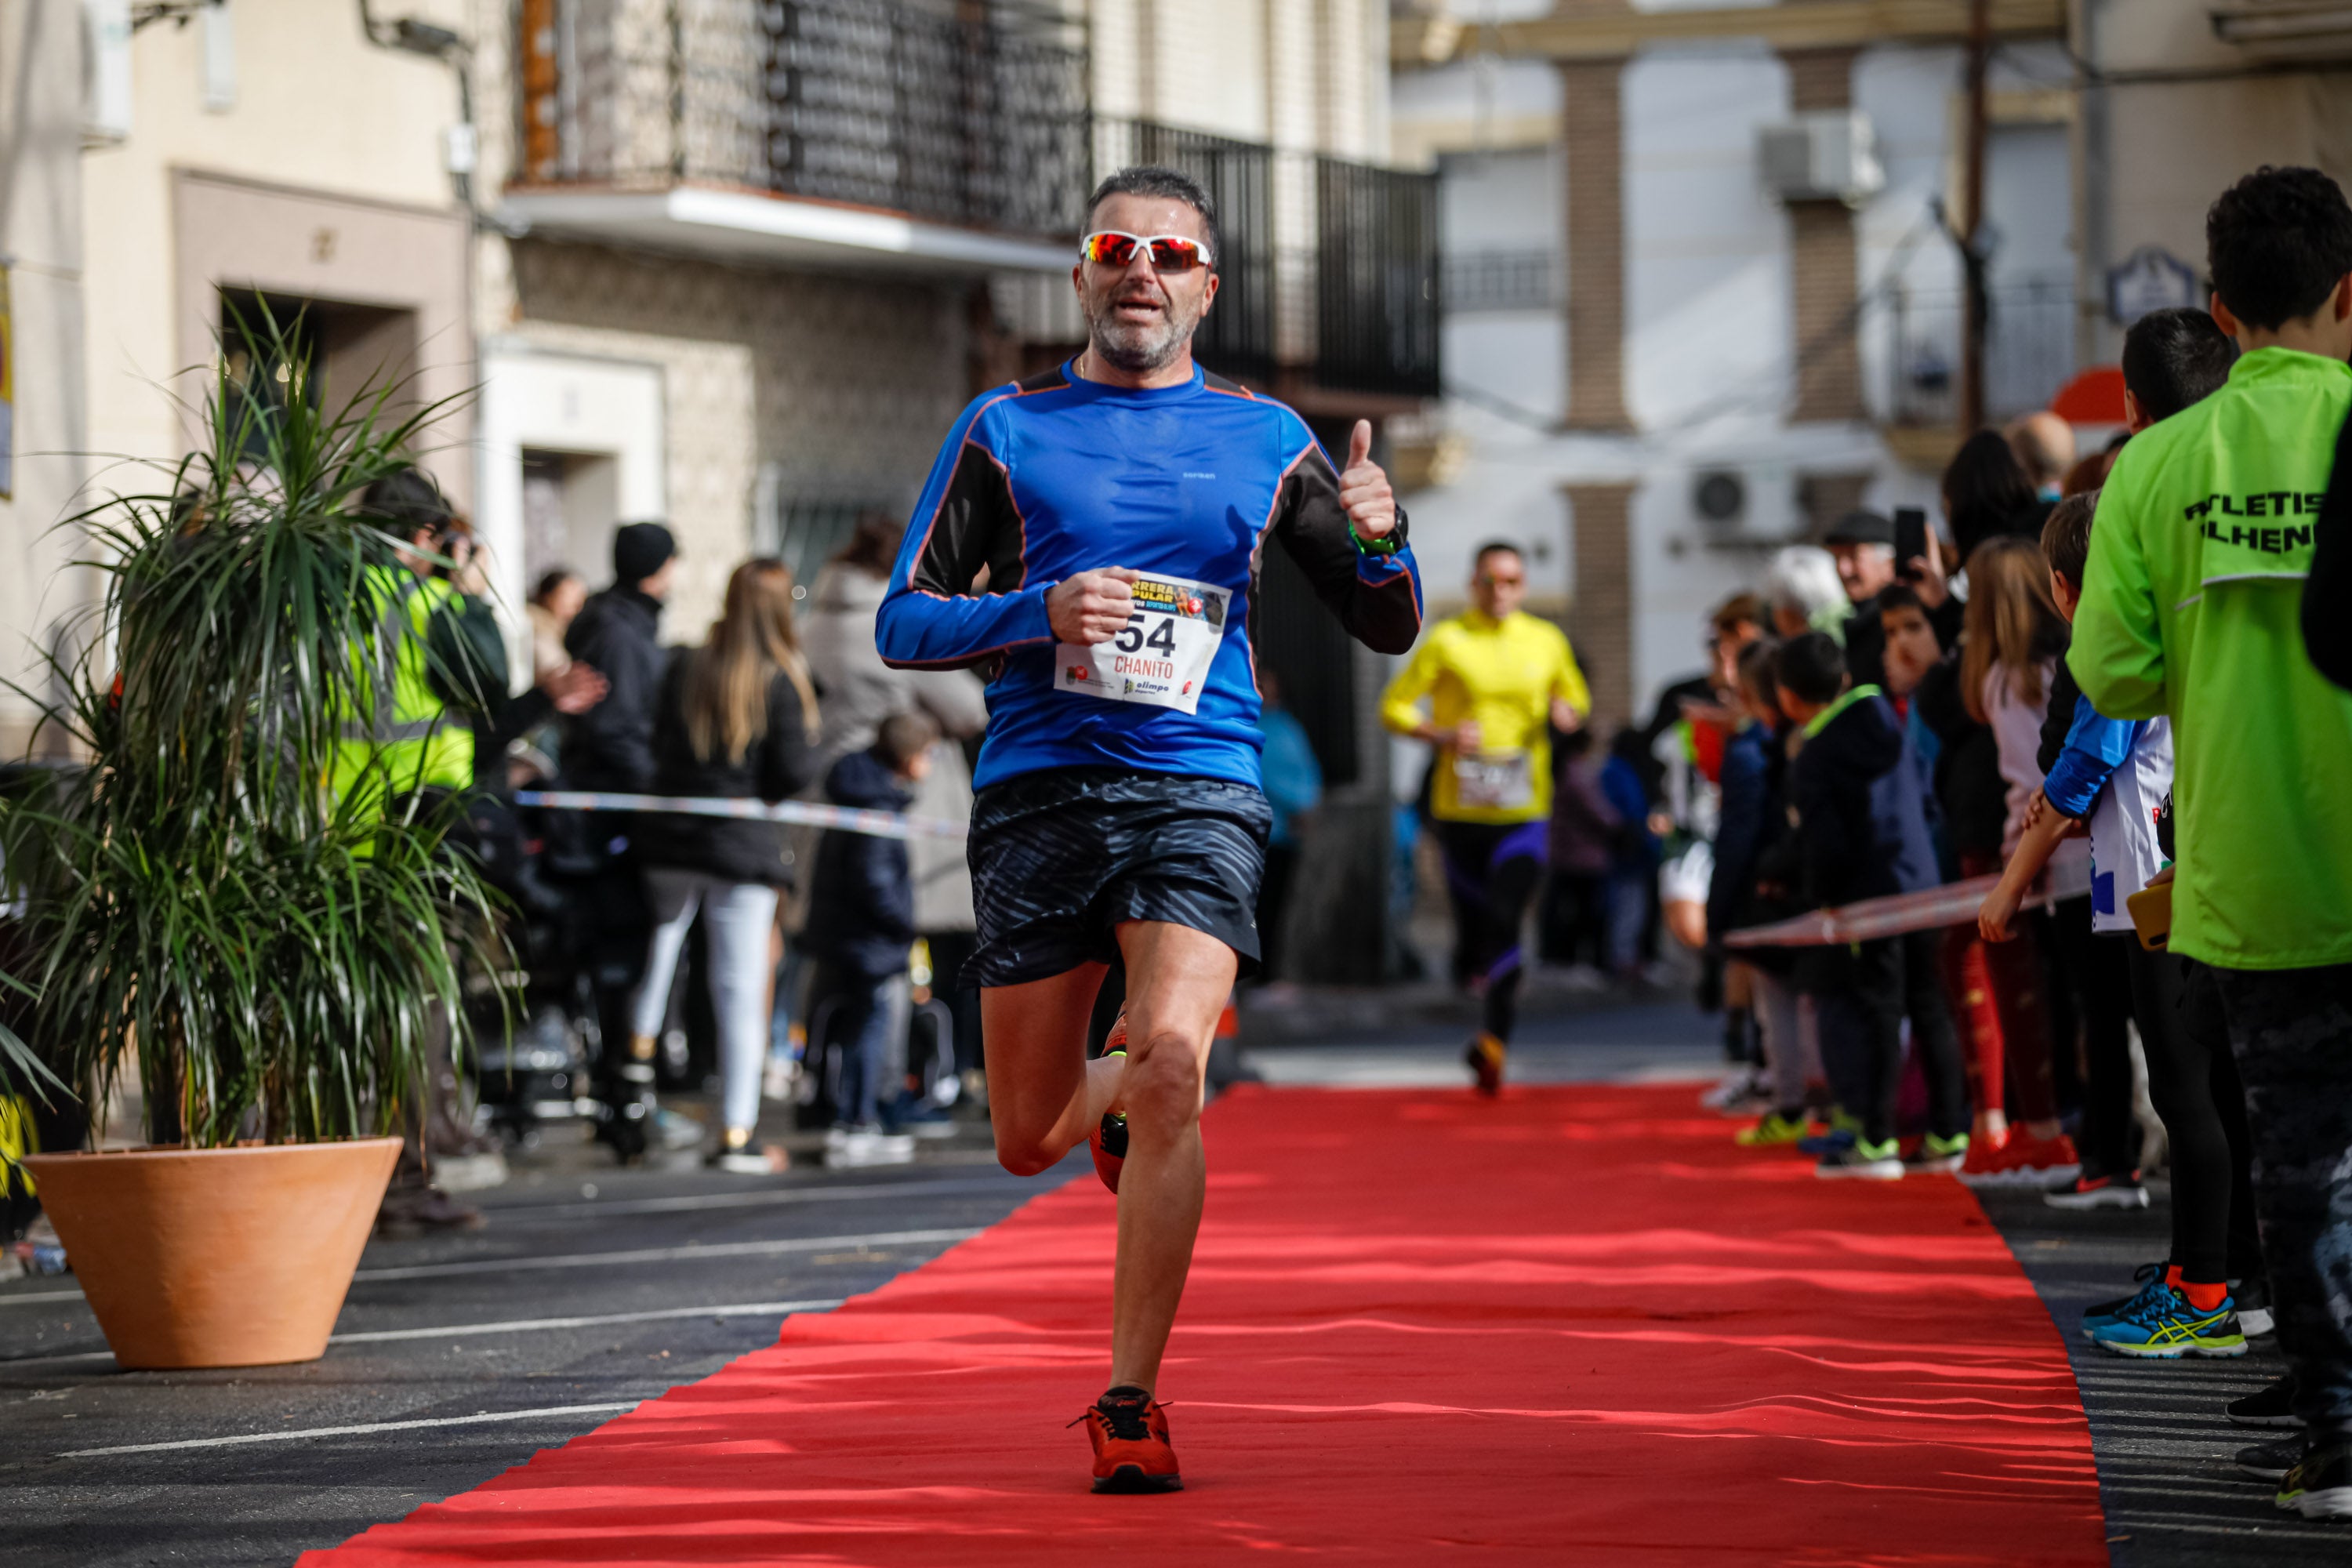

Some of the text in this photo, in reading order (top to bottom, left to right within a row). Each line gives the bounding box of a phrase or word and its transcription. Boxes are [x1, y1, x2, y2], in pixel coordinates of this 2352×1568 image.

[1115, 613, 1176, 658] 54
[1114, 655, 1174, 679] CHANITO
[1137, 681, 1169, 691] olimpo
